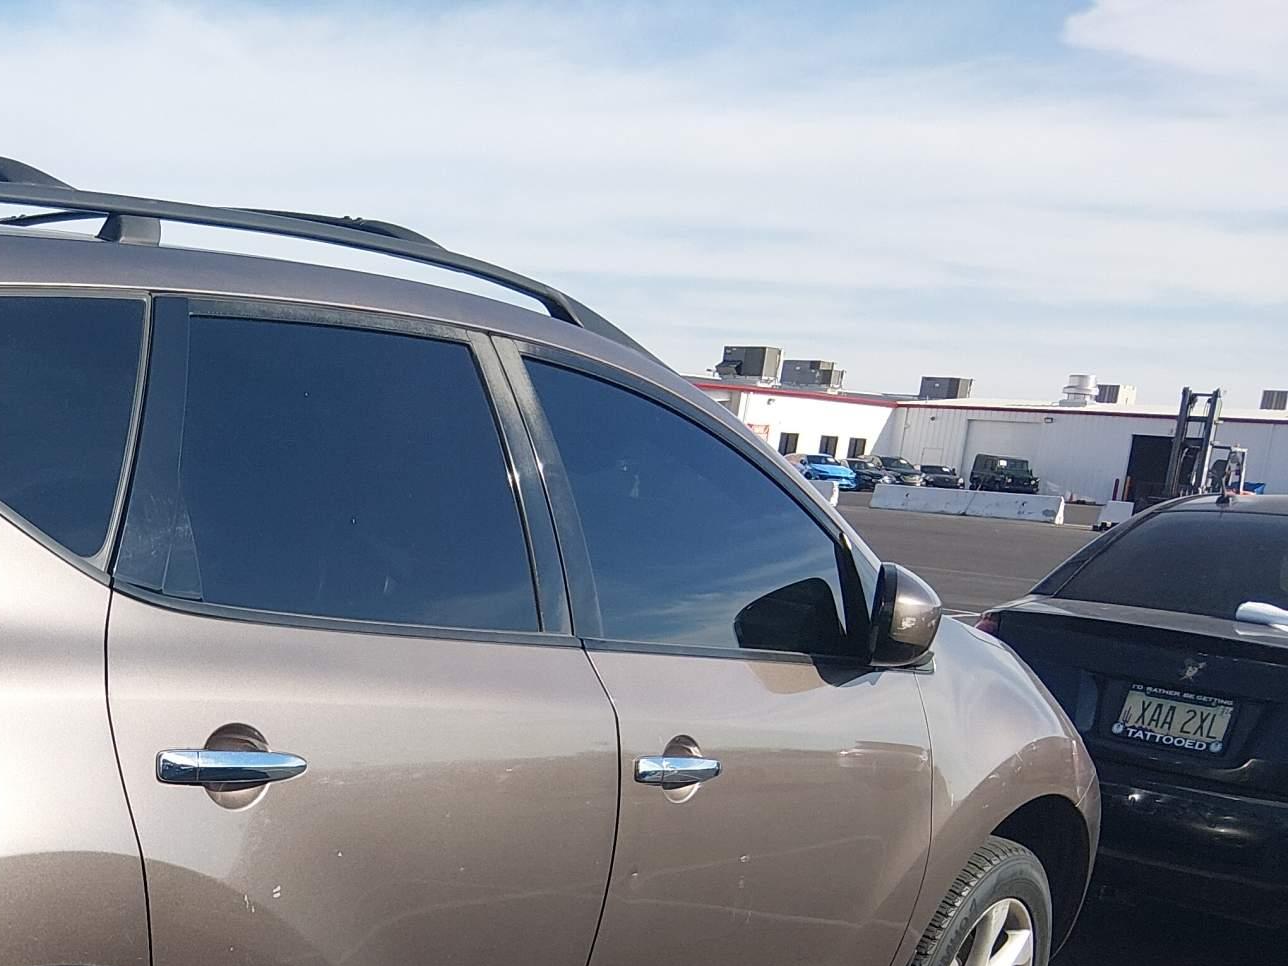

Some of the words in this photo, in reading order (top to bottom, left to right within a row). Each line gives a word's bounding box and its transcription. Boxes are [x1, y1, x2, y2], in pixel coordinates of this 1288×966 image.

[1147, 686, 1181, 697] RATHER
[1196, 695, 1233, 706] GETTING
[1136, 700, 1177, 730] XAA
[1180, 709, 1217, 739] 2XL
[1127, 728, 1207, 751] TATTOOED
